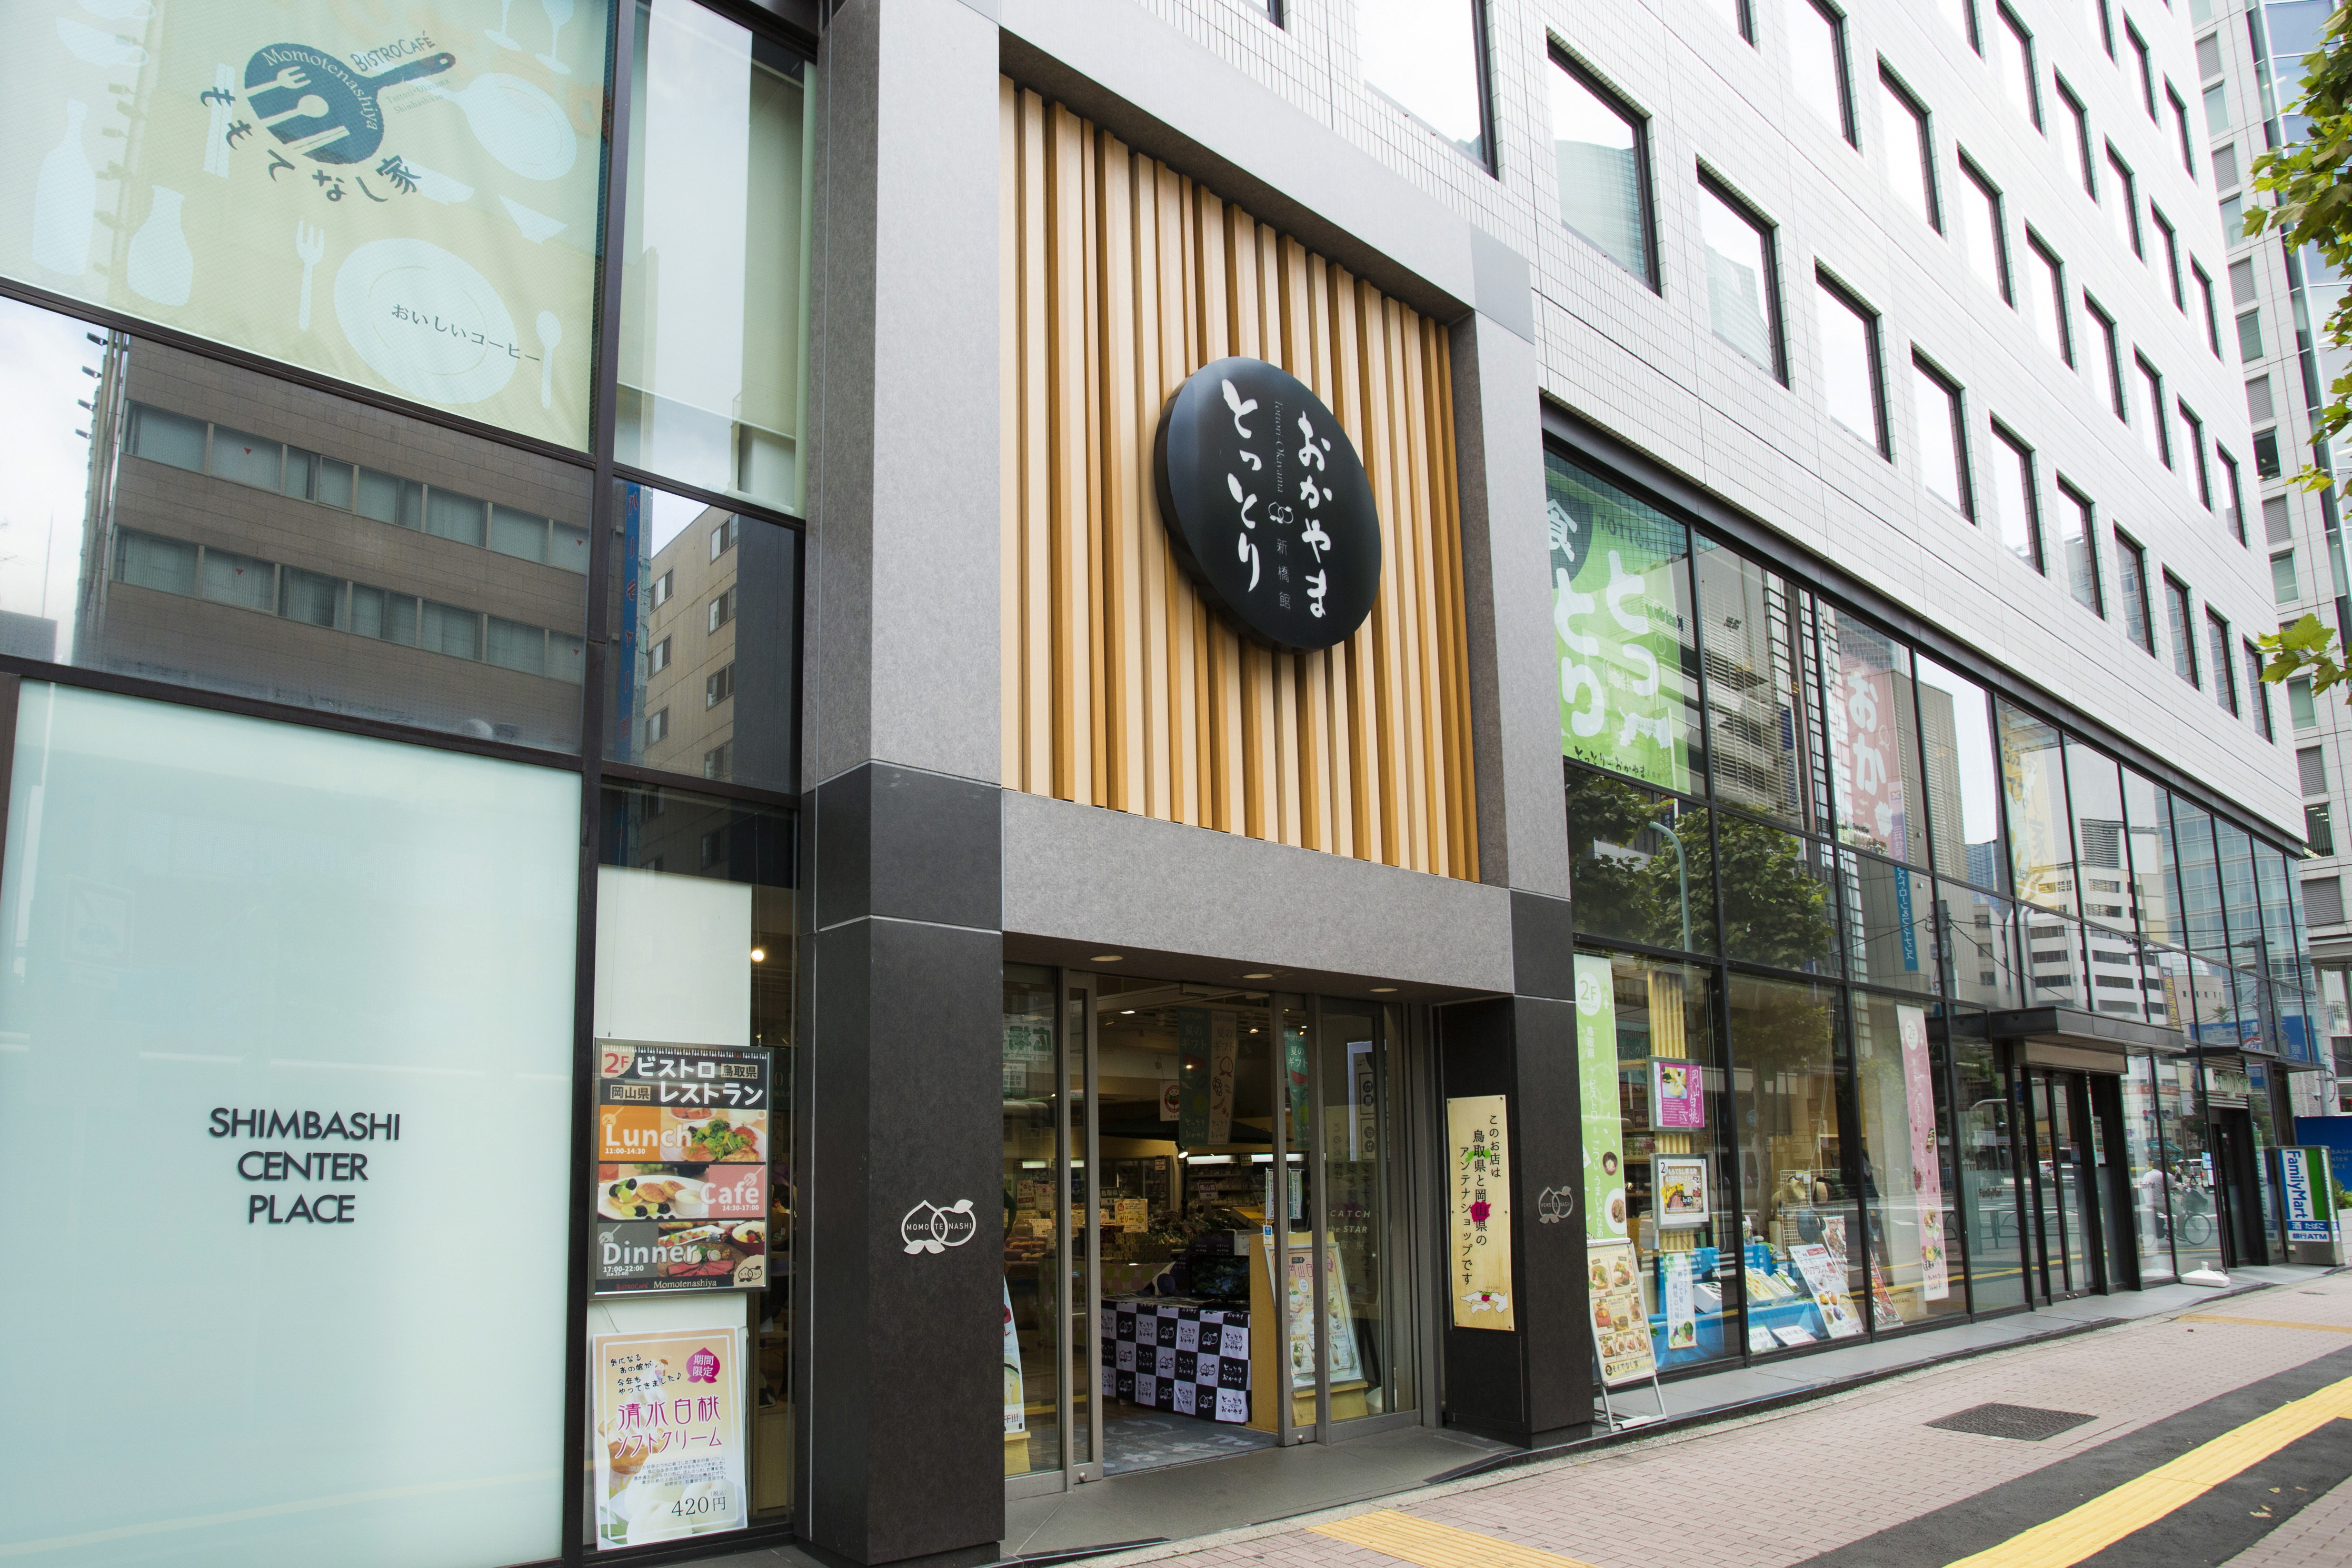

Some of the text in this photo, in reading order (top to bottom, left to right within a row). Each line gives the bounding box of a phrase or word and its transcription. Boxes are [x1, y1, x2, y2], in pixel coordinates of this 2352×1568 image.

[262, 46, 378, 131] Momotenashiya
[393, 94, 443, 114] Shimbashikan
[200, 86, 422, 203] ももてなし家
[392, 304, 540, 362] おいしいコーヒー
[1221, 378, 1262, 592] とっとり
[1298, 411, 1332, 618] おかやま
[1277, 538, 1291, 610] 新橋館
[1580, 980, 1596, 1001] 2F
[1186, 1024, 1202, 1036] 夏の
[1217, 1028, 1233, 1038] 夏の
[1908, 1025, 1915, 1040] 2F
[1181, 1038, 1207, 1050] ギフト
[1213, 1041, 1234, 1052] ギフト
[1291, 1046, 1304, 1056] 夏の
[605, 1053, 629, 1074] 2F
[636, 1056, 715, 1079] ビストロ
[722, 1064, 758, 1078] 鳥取県
[1288, 1058, 1308, 1067] ギフト
[611, 1086, 651, 1100] 岡山県
[660, 1082, 763, 1105] レストラン
[1589, 1079, 1598, 1120] ビストロ
[209, 1107, 400, 1140] SHIMBASHI
[605, 1124, 692, 1148] Lunch
[1489, 1115, 1501, 1177] このお店は
[238, 1151, 368, 1181] CENTER
[700, 1181, 759, 1205] Cafe
[1473, 1130, 1488, 1246] 鳥取県と岡山県の
[2287, 1151, 2309, 1219] FamilyMart
[249, 1194, 355, 1223] PLACE
[1330, 1210, 1371, 1218] CATCH
[1460, 1147, 1473, 1285] アンテナショップです
[1119, 1215, 1134, 1223] ゼリー
[603, 1240, 698, 1265] Dinner
[1340, 1240, 1364, 1250] 取県
[653, 1279, 717, 1289] Momotenashiya
[1225, 1342, 1242, 1351] おかやま
[1226, 1332, 1242, 1341] とっとり
[610, 1354, 641, 1367] 気になる
[620, 1361, 652, 1374] あの娘が
[693, 1354, 714, 1366] 期間
[1224, 1364, 1242, 1373] とっとり
[617, 1376, 641, 1387] 今年も
[693, 1366, 713, 1377] 限定
[1223, 1374, 1242, 1383] おかやま
[1222, 1396, 1242, 1404] とっとり
[617, 1395, 722, 1432] 清水白桃
[614, 1426, 722, 1459] ソフトクリーム
[671, 1496, 726, 1517] 420円
